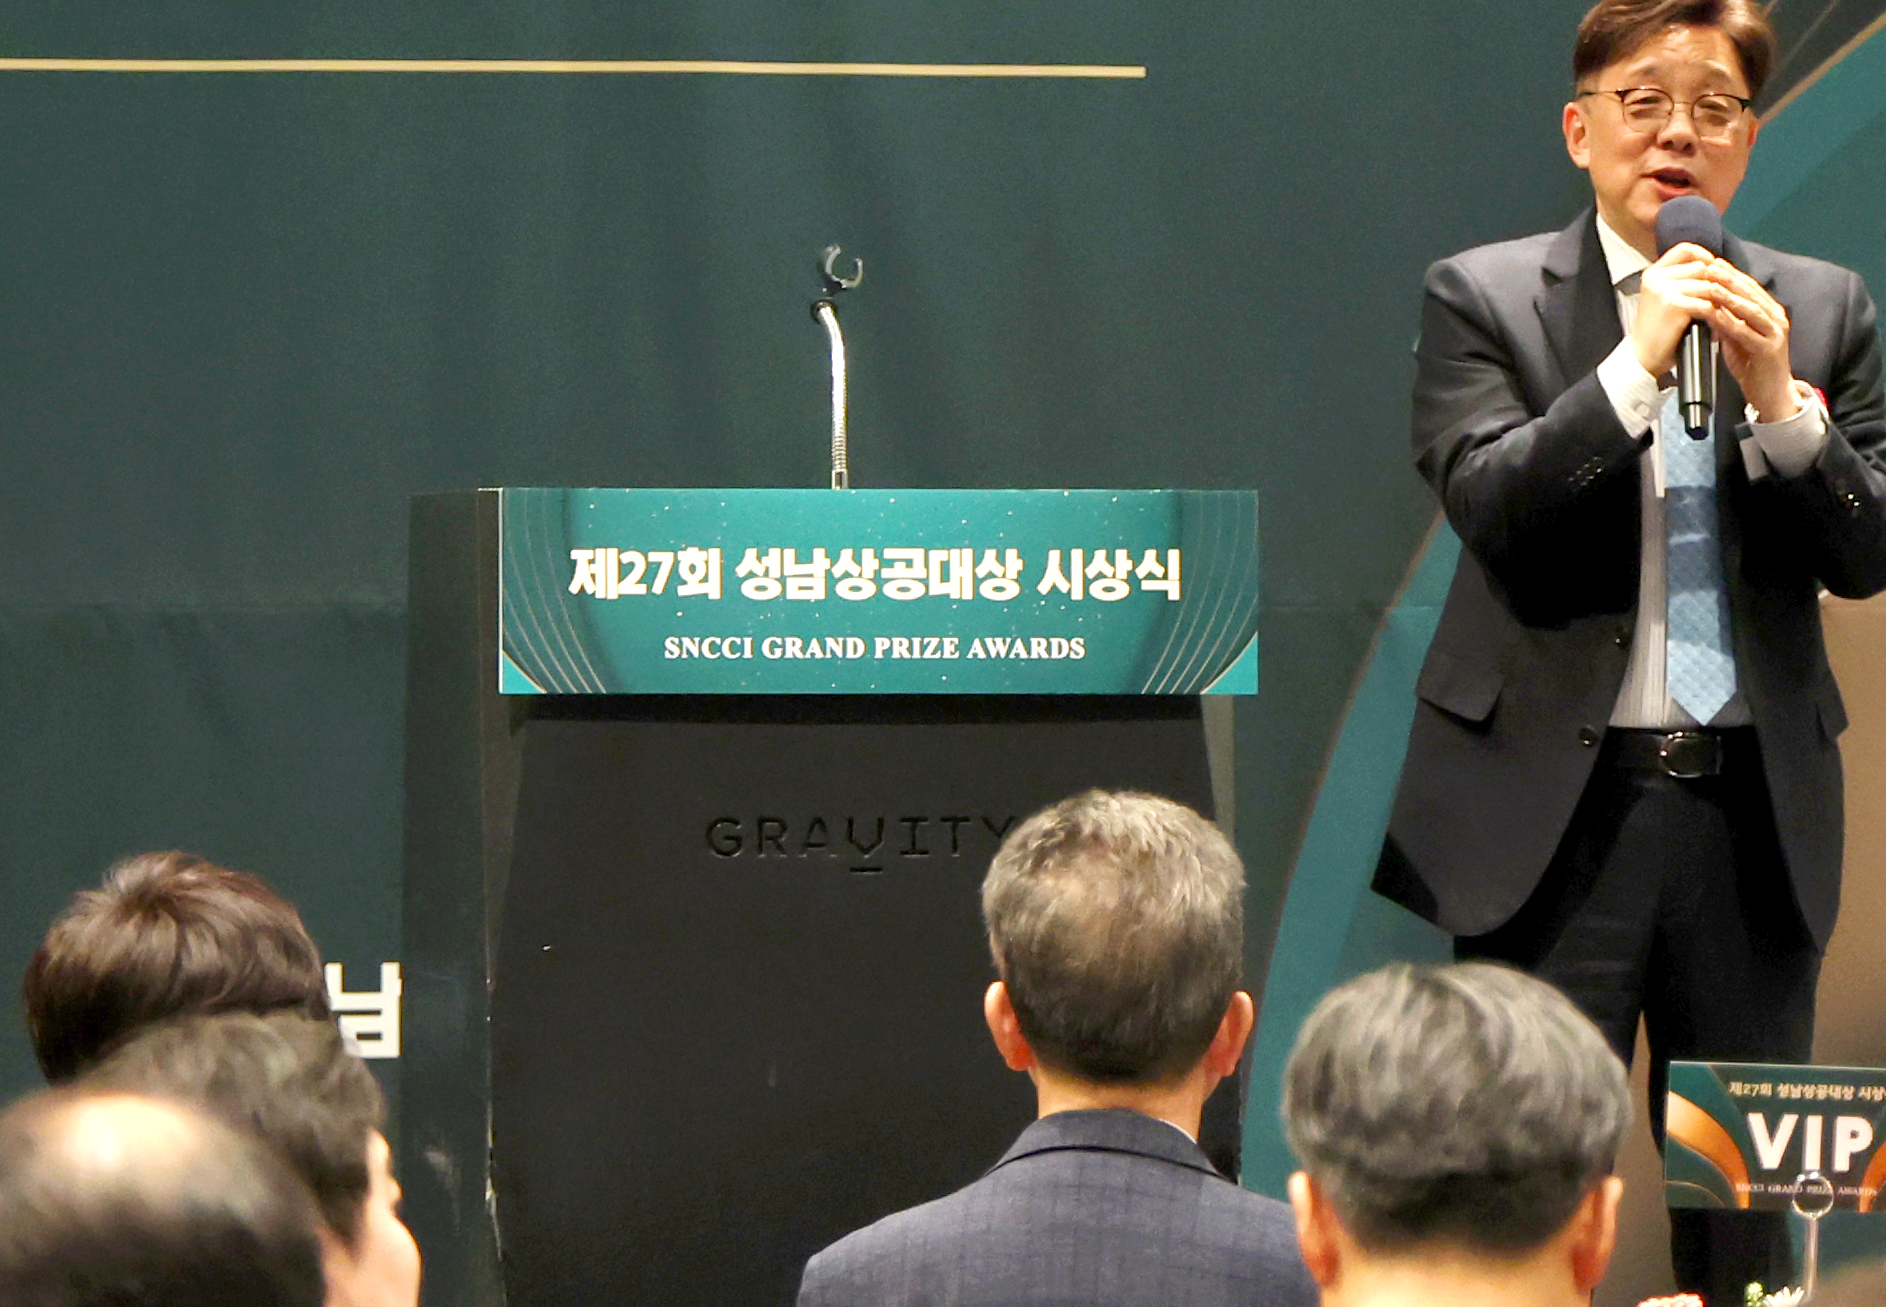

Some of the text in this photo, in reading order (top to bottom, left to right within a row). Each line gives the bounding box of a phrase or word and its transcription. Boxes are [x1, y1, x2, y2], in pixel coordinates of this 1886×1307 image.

[568, 546, 1181, 602] 제27회 성남상공대상 시상식
[665, 637, 1085, 659] SNCCI GRAND PRIZE AWARDS
[1747, 1112, 1874, 1173] VIP
